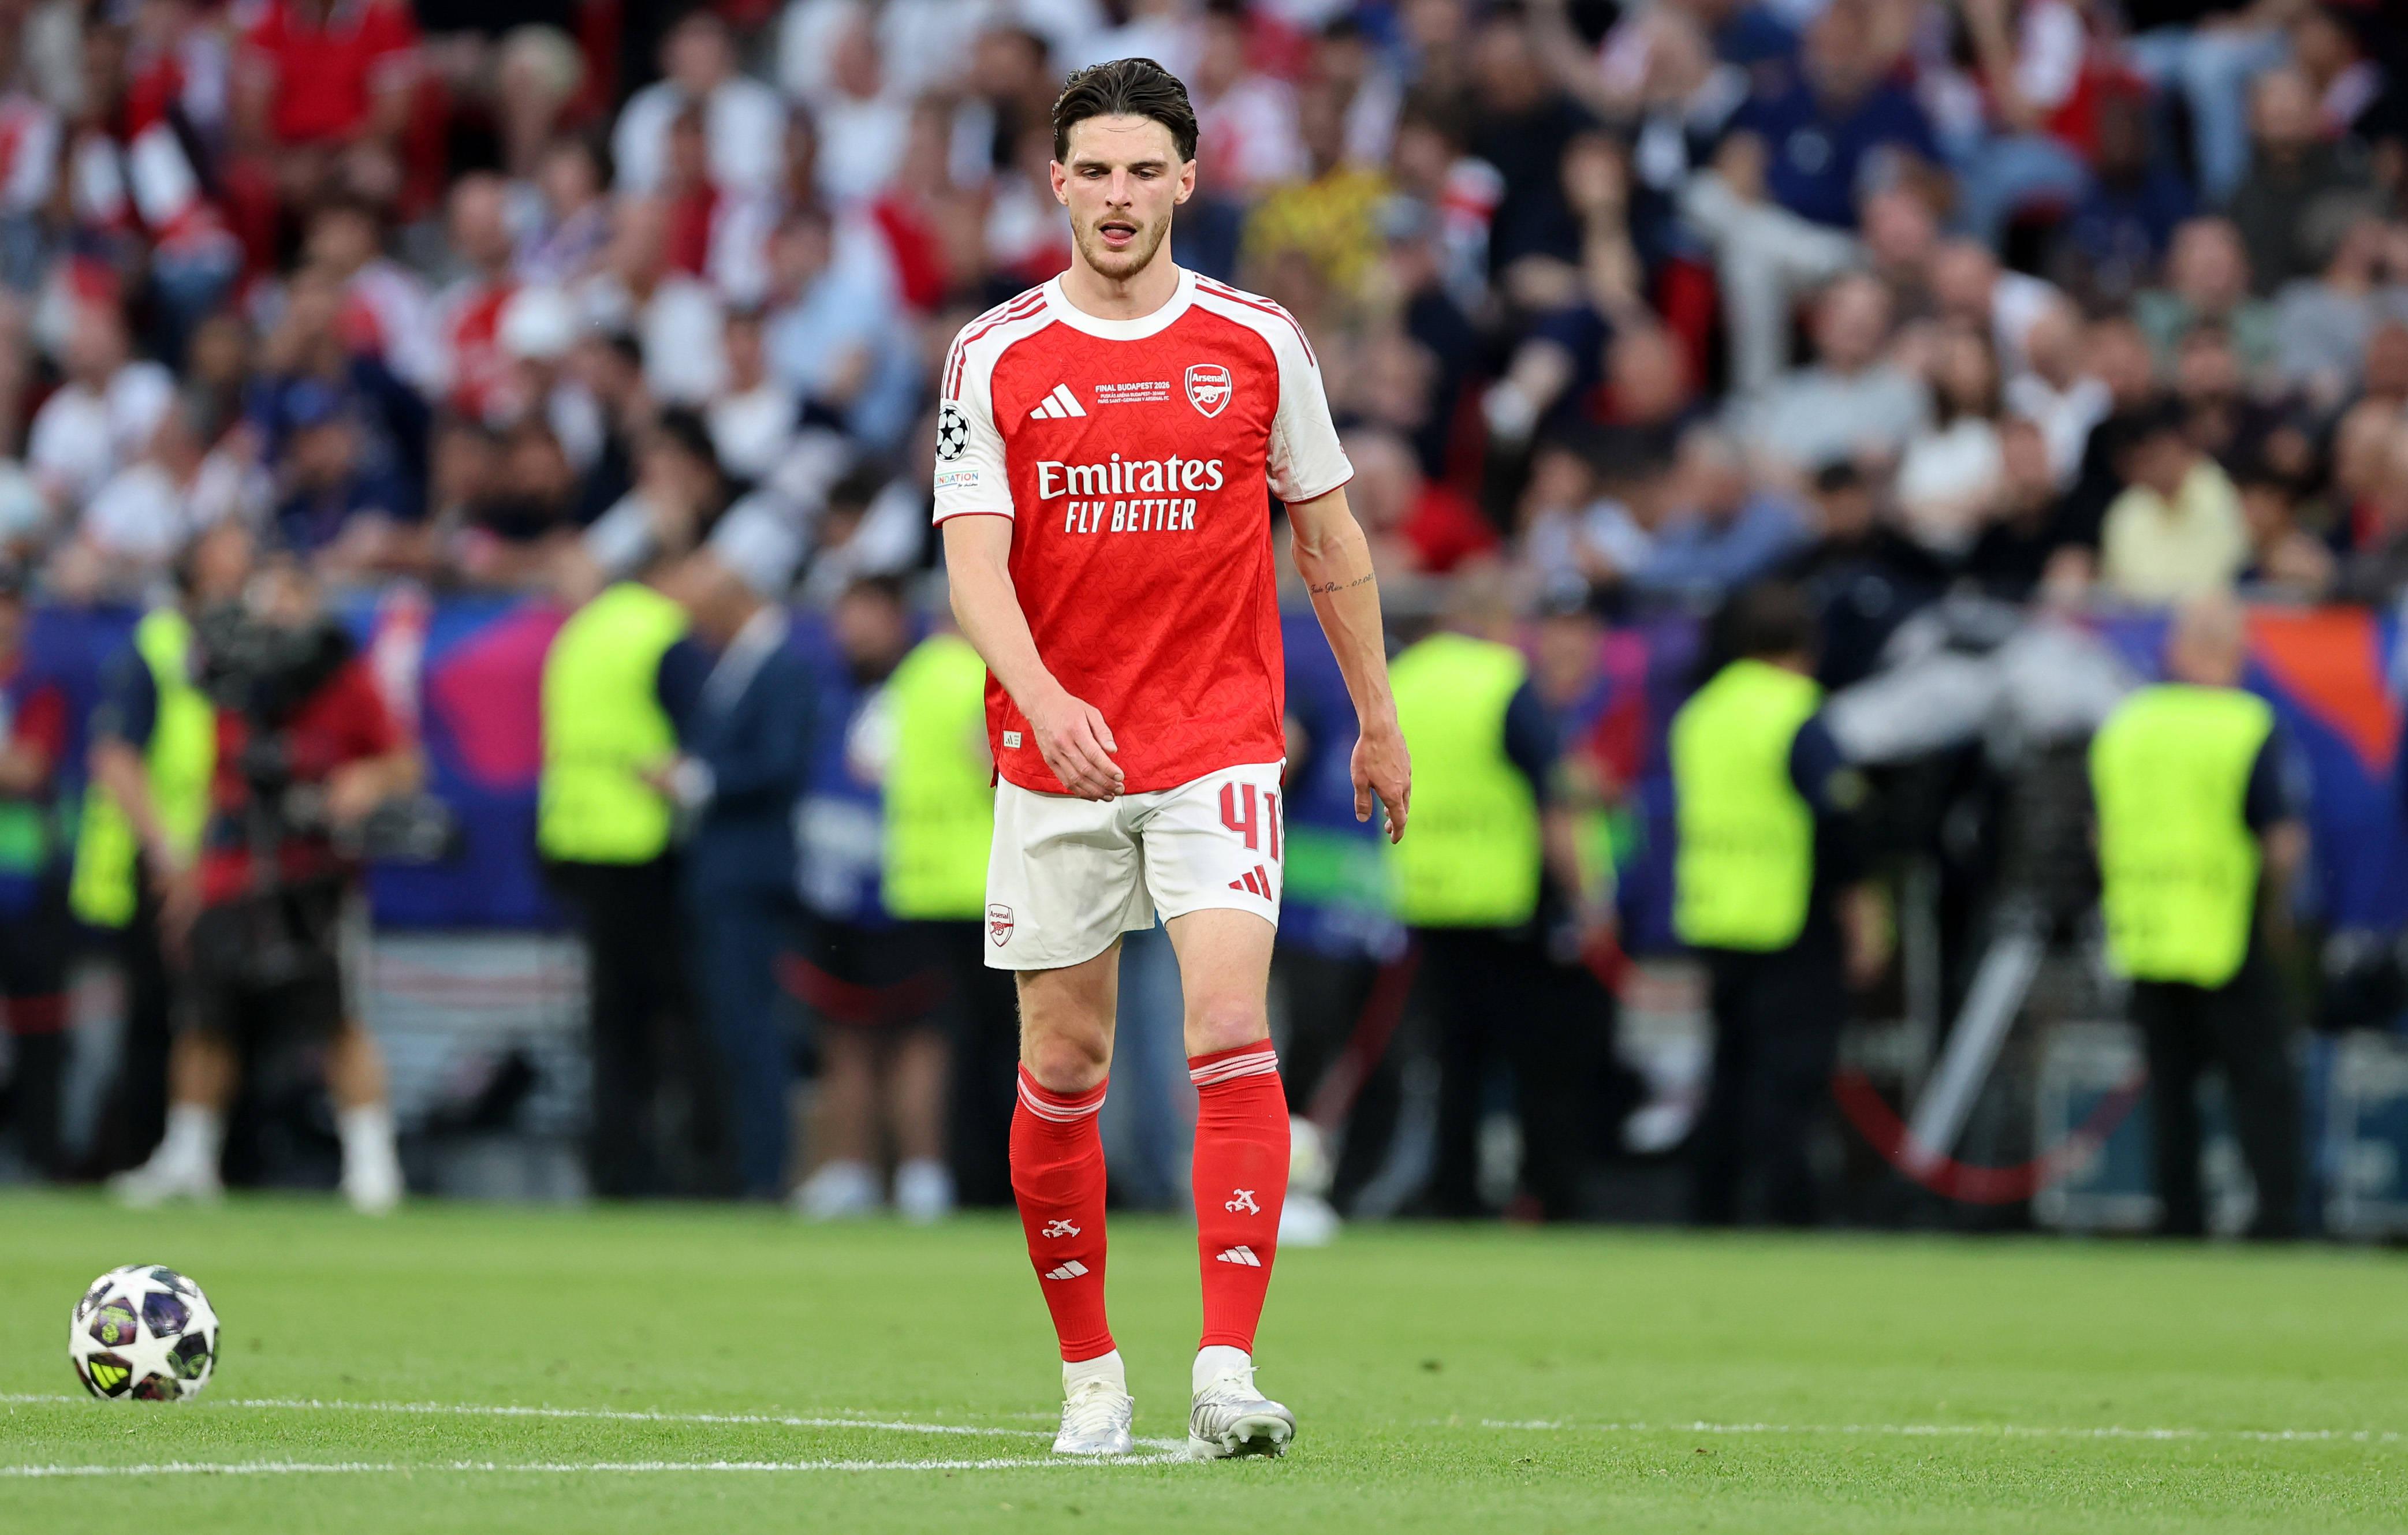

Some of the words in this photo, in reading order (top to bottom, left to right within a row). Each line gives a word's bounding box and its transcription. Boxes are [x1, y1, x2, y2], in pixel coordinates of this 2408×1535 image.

[1095, 384, 1116, 393] FINAL
[1117, 382, 1153, 391] BUDAPEST
[1154, 381, 1171, 389] 2026
[1192, 373, 1225, 382] Arsenal
[1037, 453, 1224, 500] Emirates
[1065, 501, 1105, 533] FLY
[1110, 498, 1197, 532] BETTER
[1218, 781, 1279, 864] 41
[990, 911, 1009, 920] Arsenal
